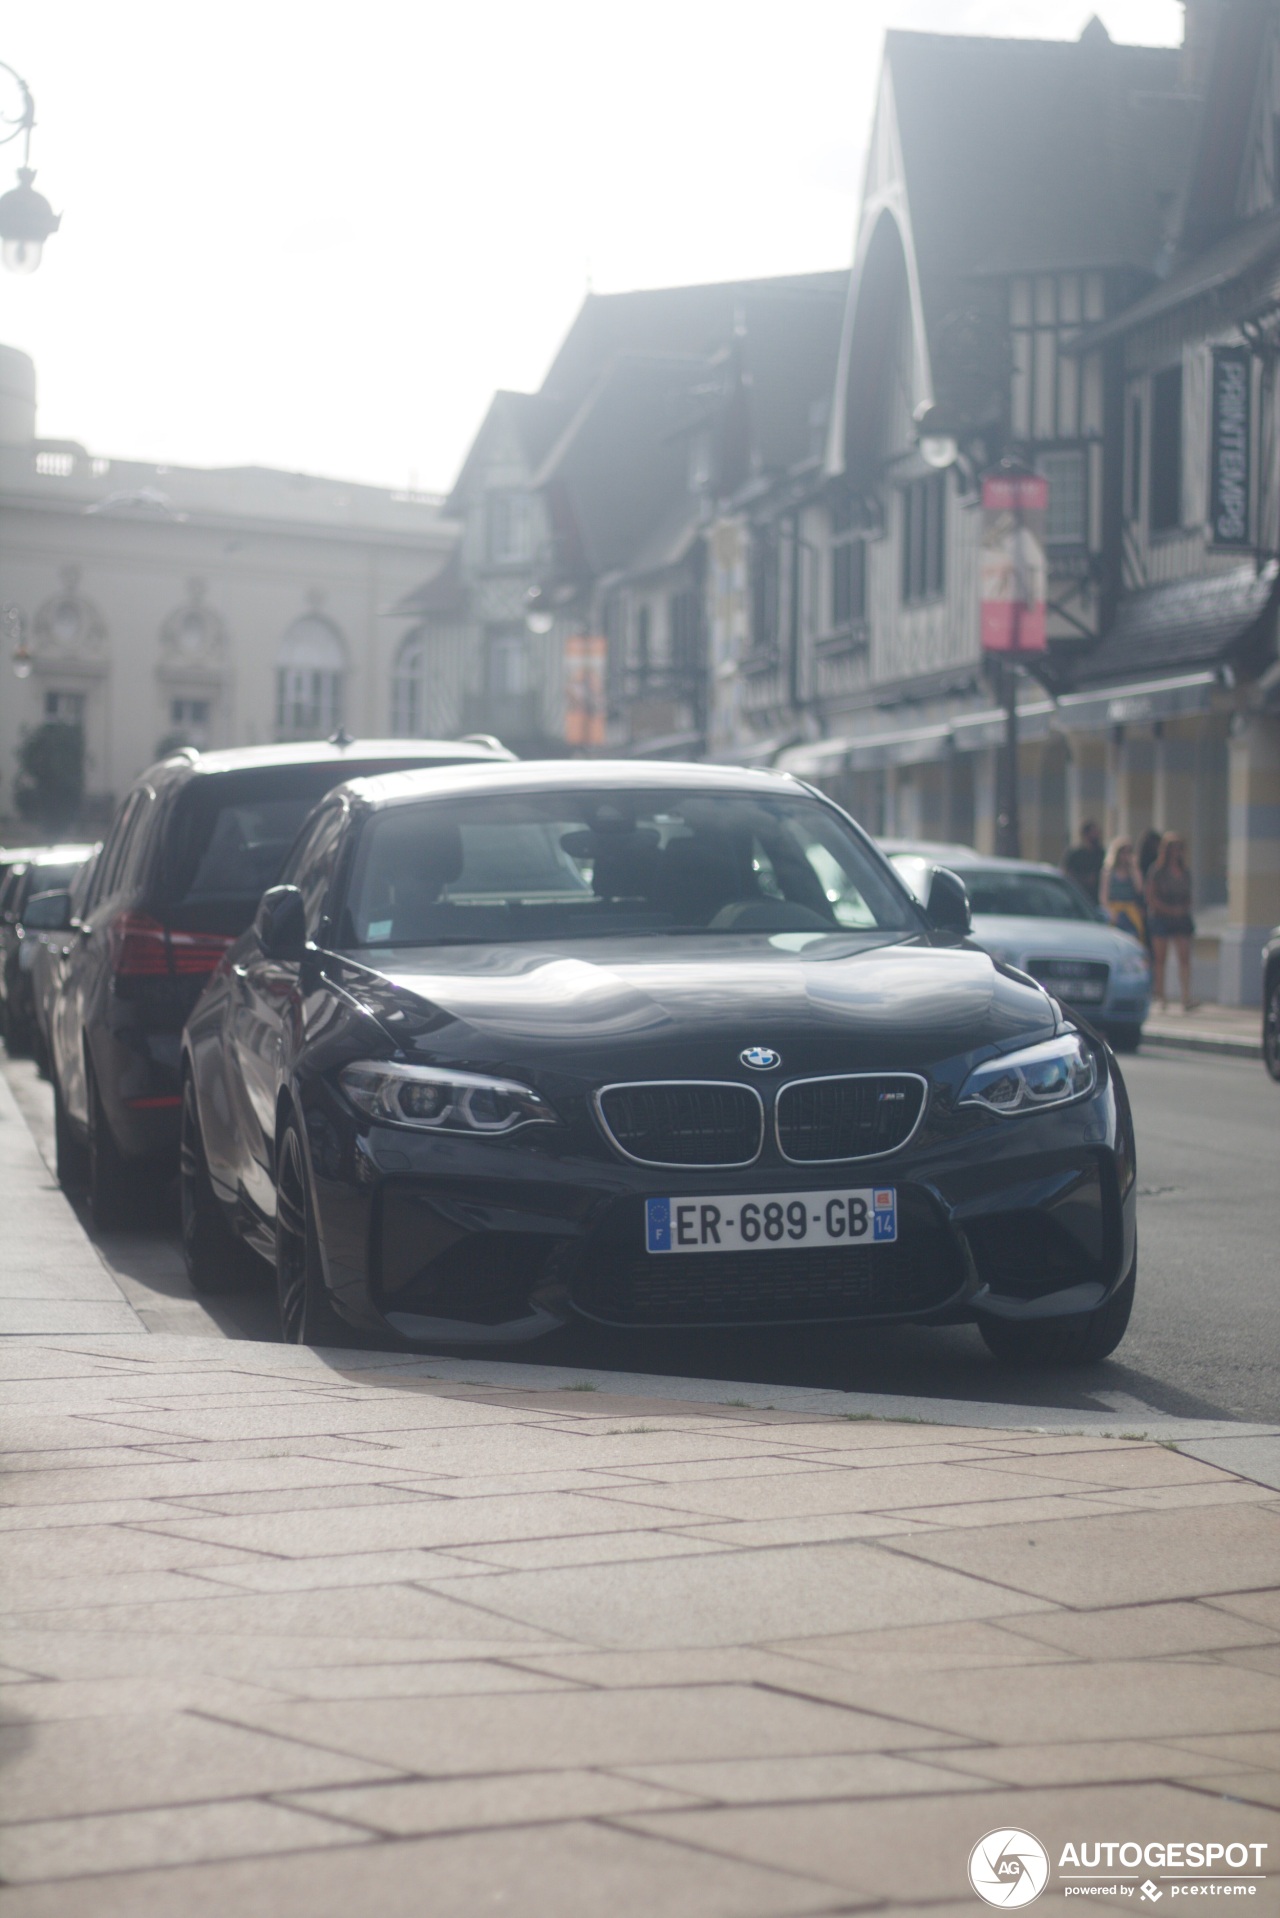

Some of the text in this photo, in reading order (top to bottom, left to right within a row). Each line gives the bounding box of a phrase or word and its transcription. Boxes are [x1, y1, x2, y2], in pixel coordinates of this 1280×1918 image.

[1216, 361, 1247, 539] PRINTEMPS
[655, 1229, 664, 1241] F
[676, 1197, 869, 1246] ER-689-GB
[876, 1214, 893, 1234] 14
